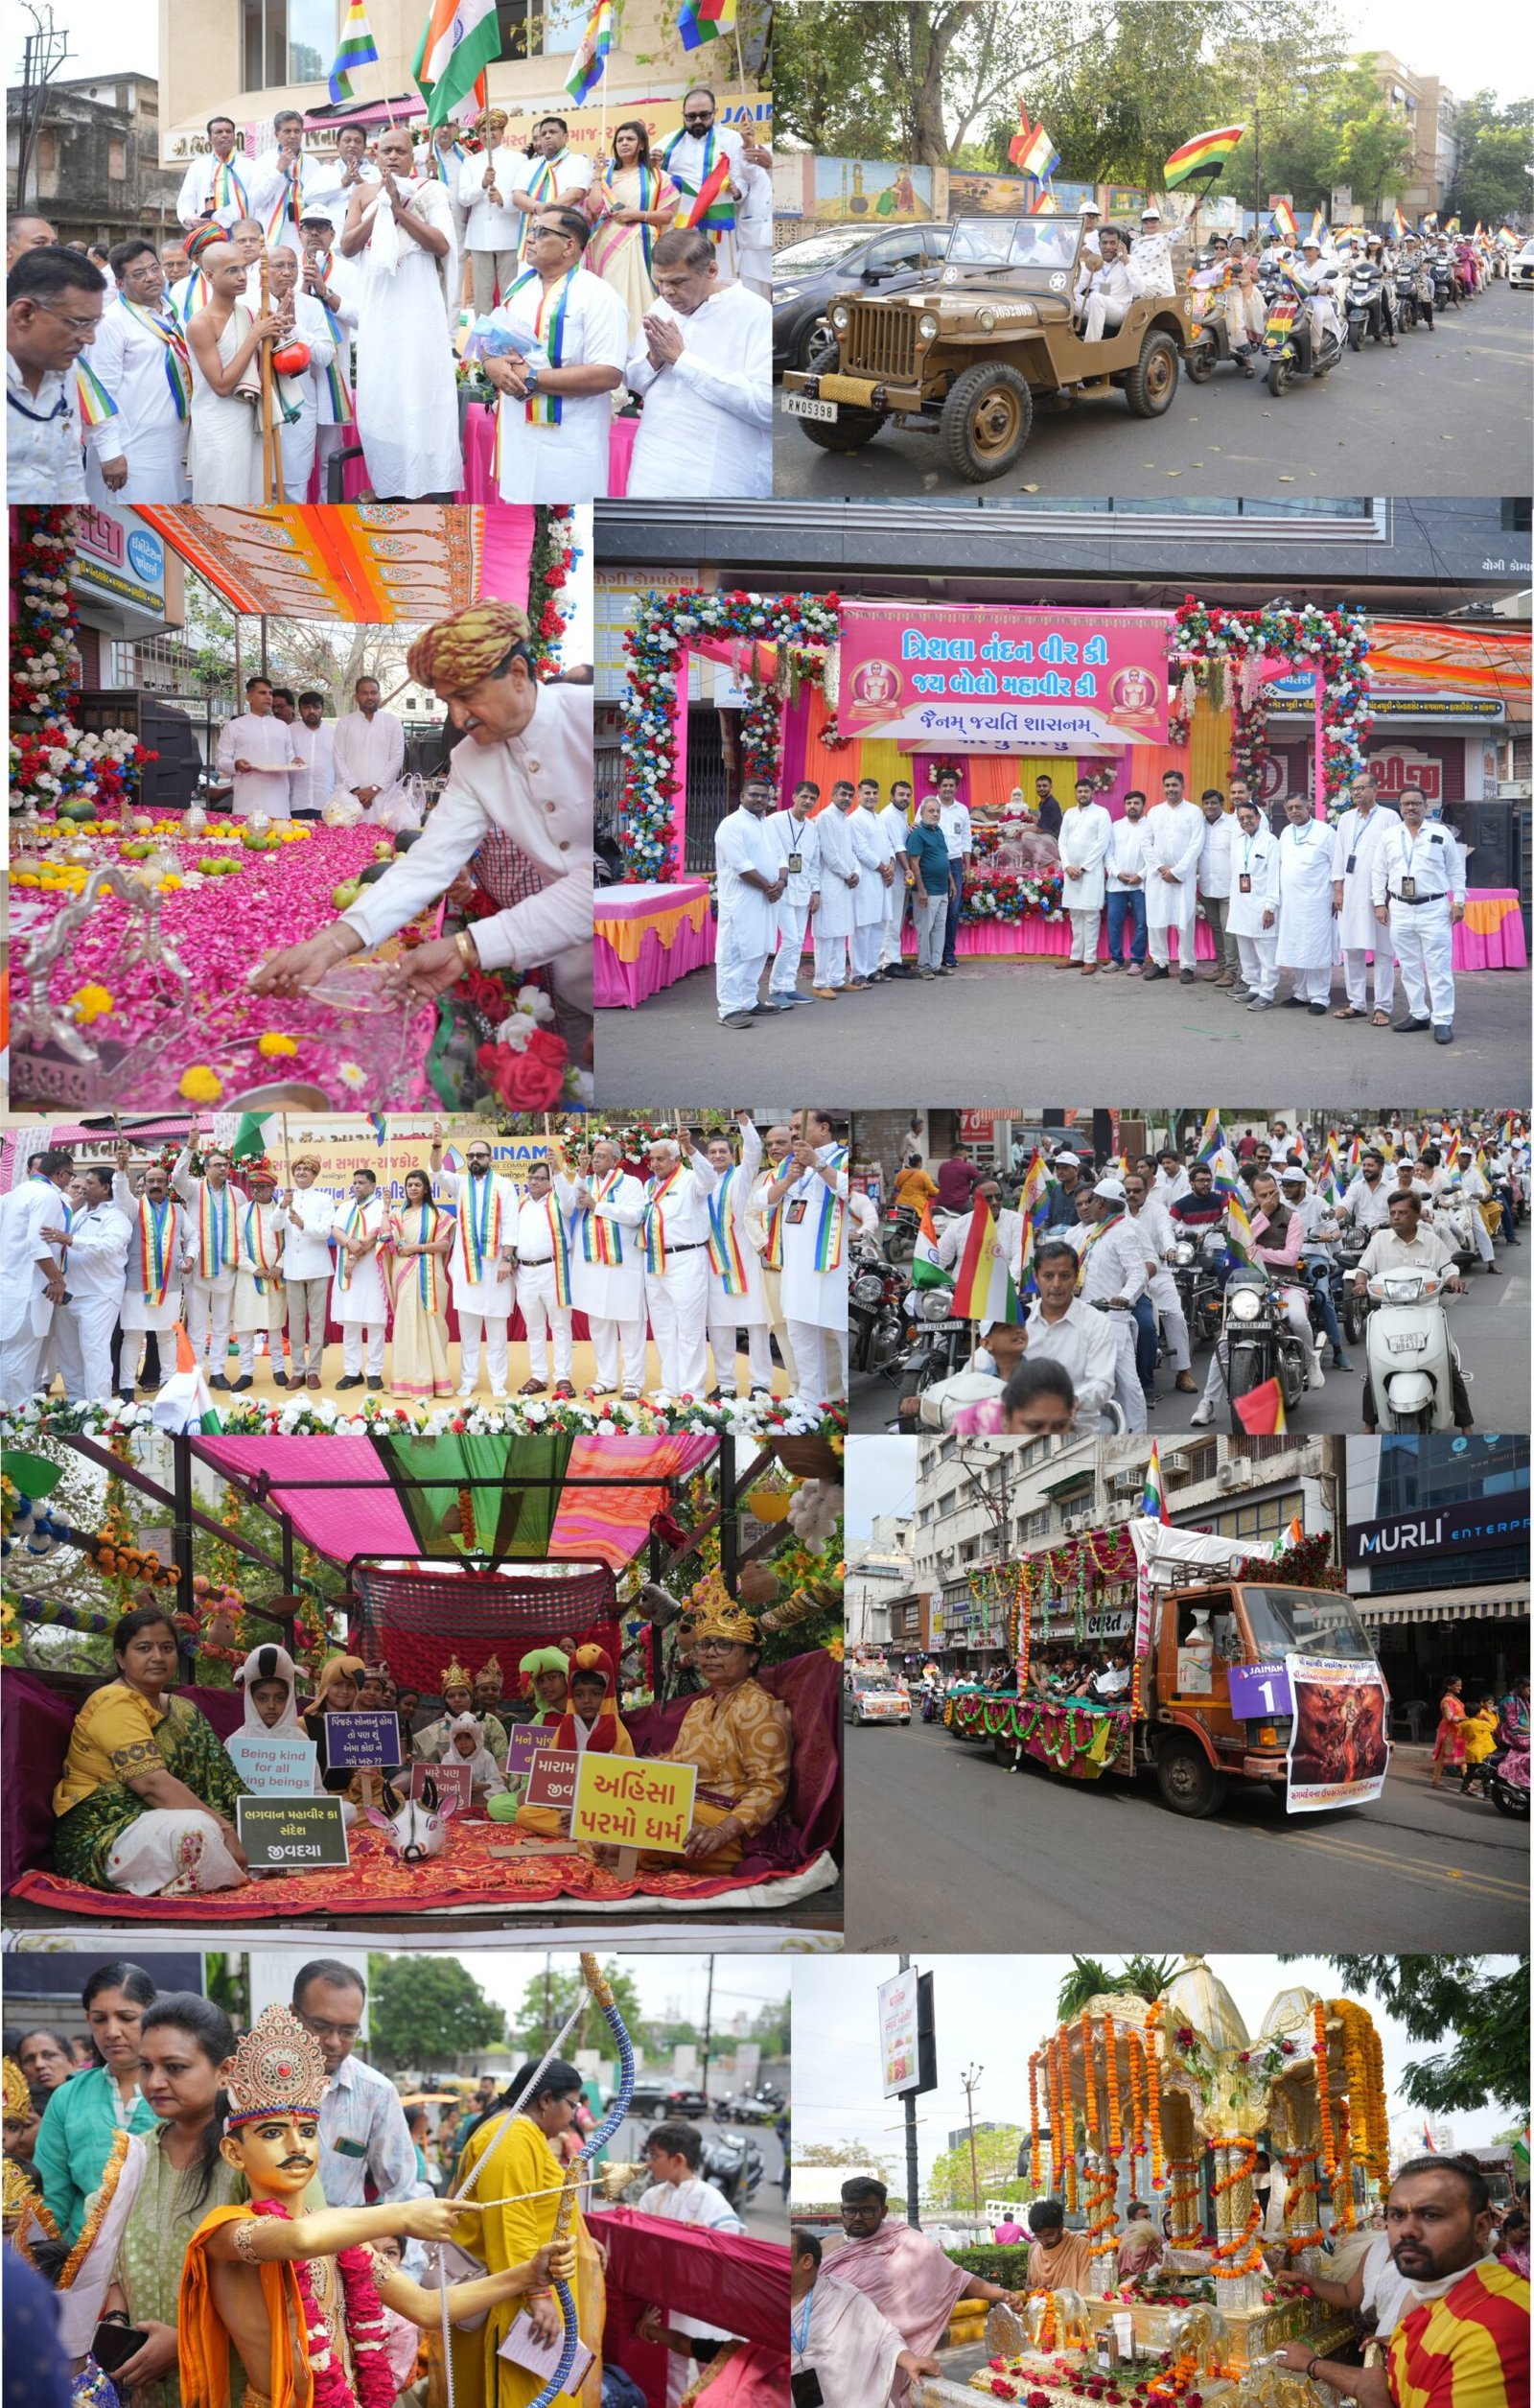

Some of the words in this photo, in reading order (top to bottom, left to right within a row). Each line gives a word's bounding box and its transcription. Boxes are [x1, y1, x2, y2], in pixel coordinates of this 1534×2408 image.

[1481, 558, 1505, 571] યોગી
[1510, 559, 1532, 572] કોમ્પ
[901, 628, 976, 660] ત્રિશલા
[980, 631, 1035, 663] નંદન
[1039, 633, 1079, 665] વીર
[1082, 634, 1109, 666] કી
[912, 672, 945, 693] જય
[950, 667, 998, 695] બોલો
[1002, 670, 1072, 697] મહાવીર
[1074, 670, 1097, 697] કી
[919, 710, 967, 735] જૈનમ્
[1023, 714, 1100, 738] શાસનમ્
[493, 1145, 548, 1160] INAM
[1359, 1517, 1442, 1556] MURLI
[1249, 1665, 1284, 1675] JAINAM
[1258, 1681, 1275, 1713] 1
[379, 1715, 392, 1725] હોય
[347, 1728, 356, 1740] તો
[515, 1732, 532, 1746] મને
[375, 1741, 383, 1752] ને
[241, 1748, 276, 1762] Being
[280, 1750, 306, 1761] kind
[255, 1762, 273, 1772] for
[275, 1764, 291, 1773] all
[443, 1768, 459, 1778] પણ
[269, 1776, 311, 1789] beings
[593, 1769, 676, 1806] અહિંસા
[244, 1809, 285, 1821] ભગવાન
[287, 1807, 324, 1821] મહાવીર
[327, 1809, 338, 1821] કા
[279, 1825, 306, 1837] સંદેશ
[580, 1807, 637, 1838] પરમો
[645, 1813, 686, 1844] ધર્મ
[267, 1842, 322, 1860] જીવદયા
